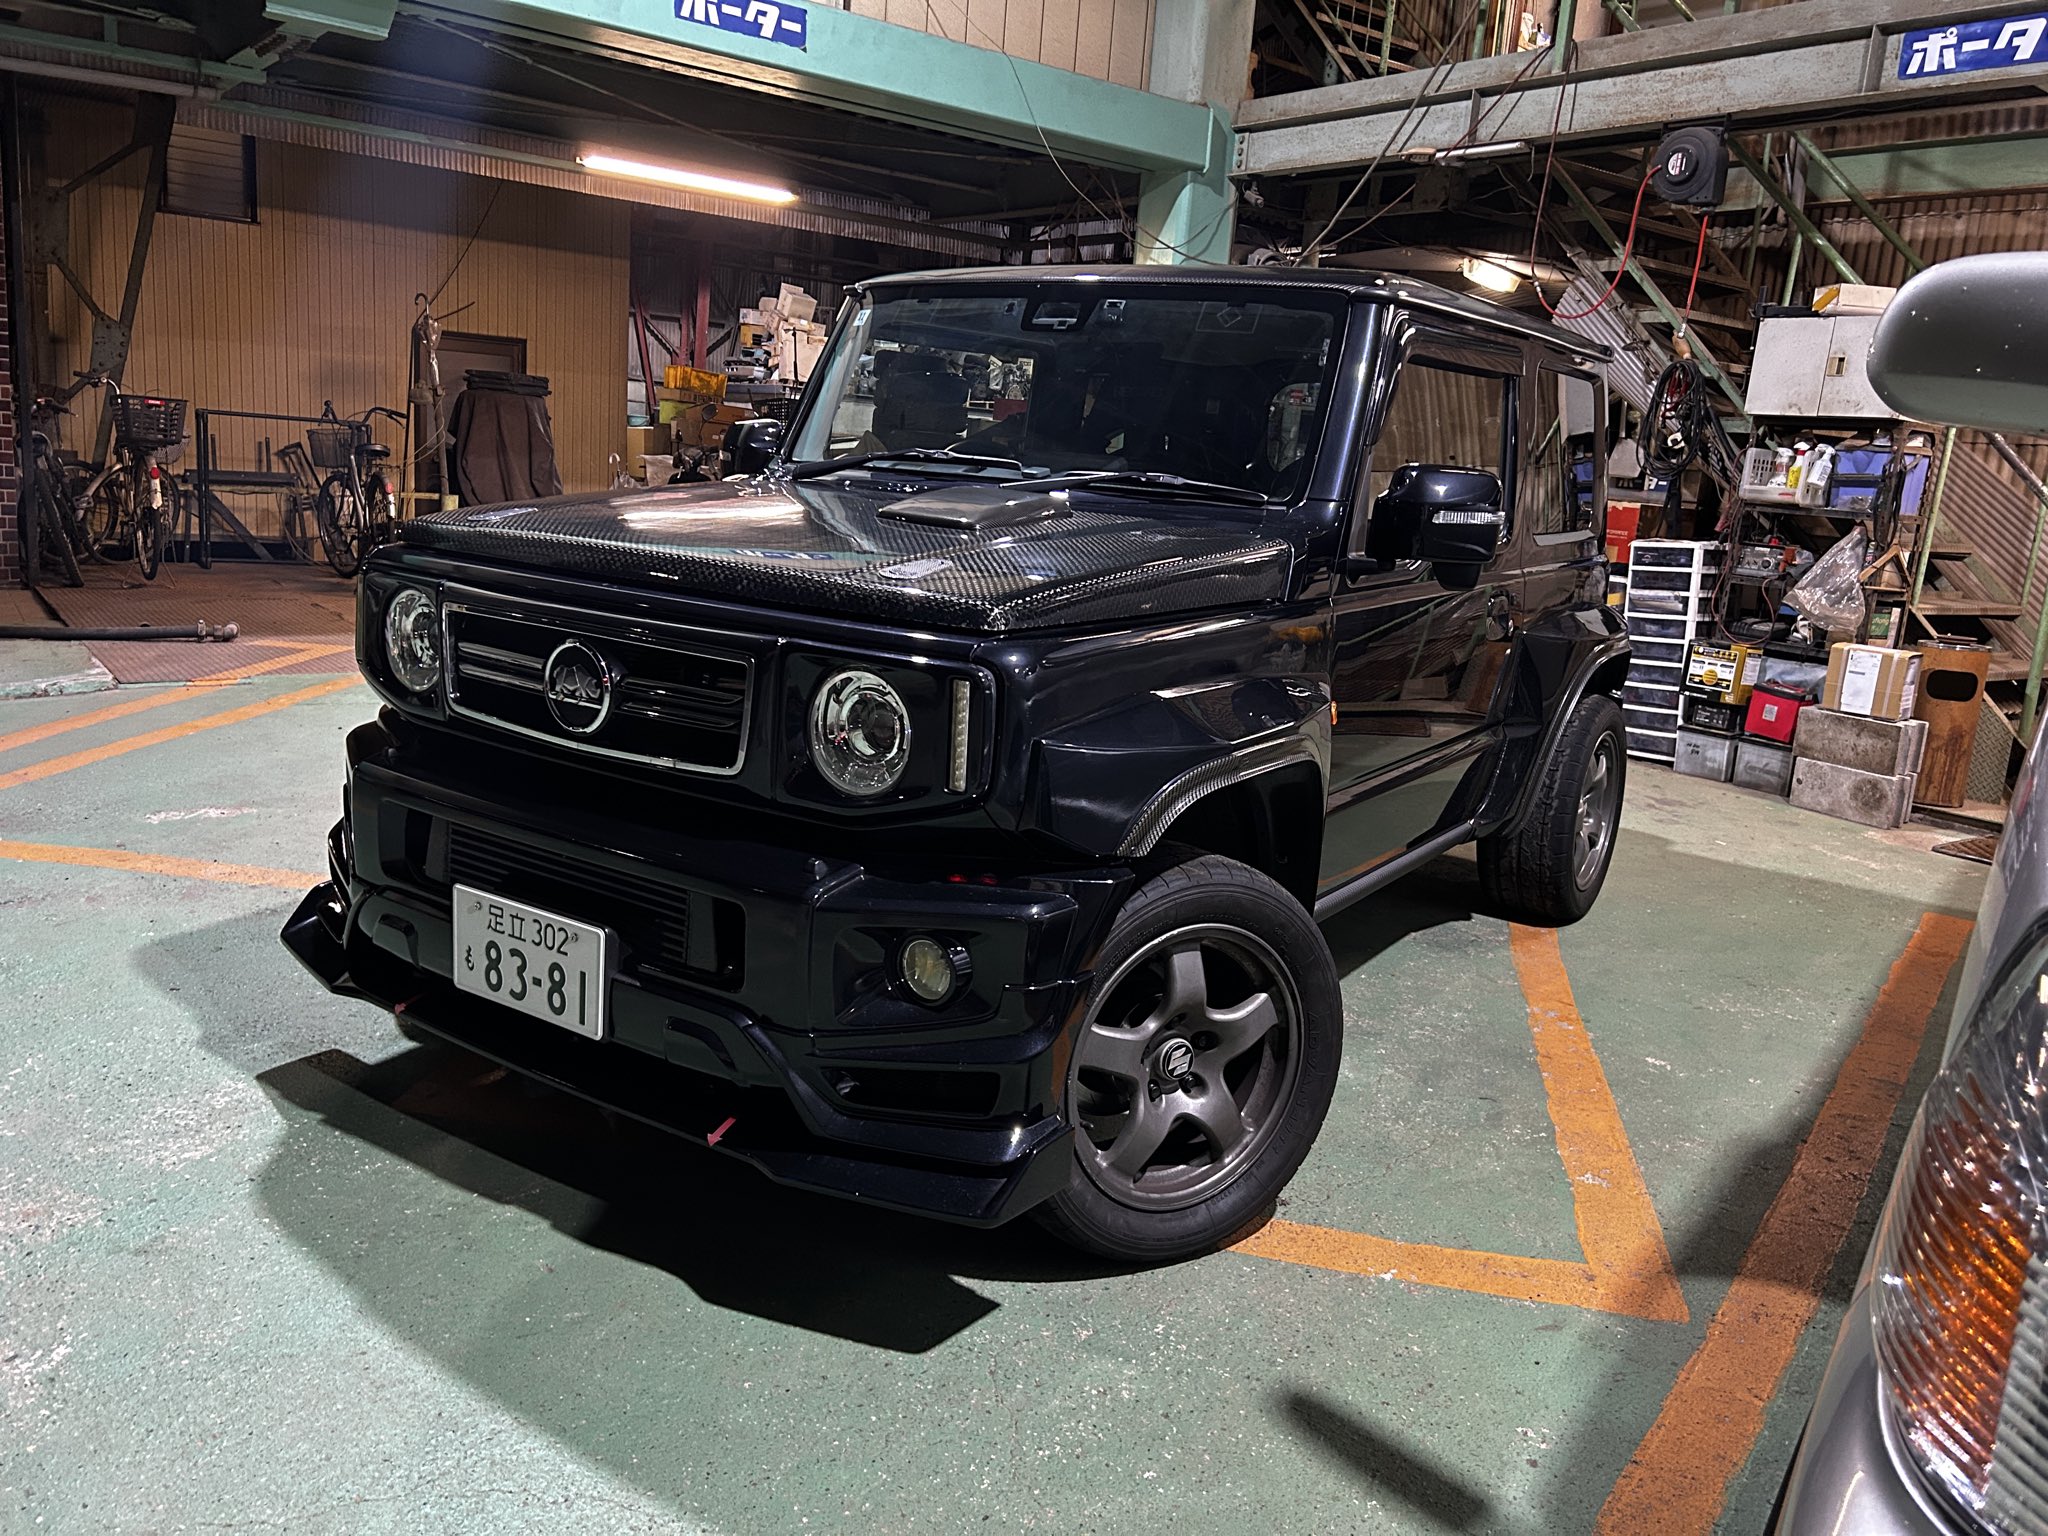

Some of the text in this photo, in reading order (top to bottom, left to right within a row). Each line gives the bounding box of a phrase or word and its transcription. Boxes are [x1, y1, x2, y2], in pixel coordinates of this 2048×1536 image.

[487, 904, 569, 956] 足立 302
[464, 939, 586, 1026] も 83-81
